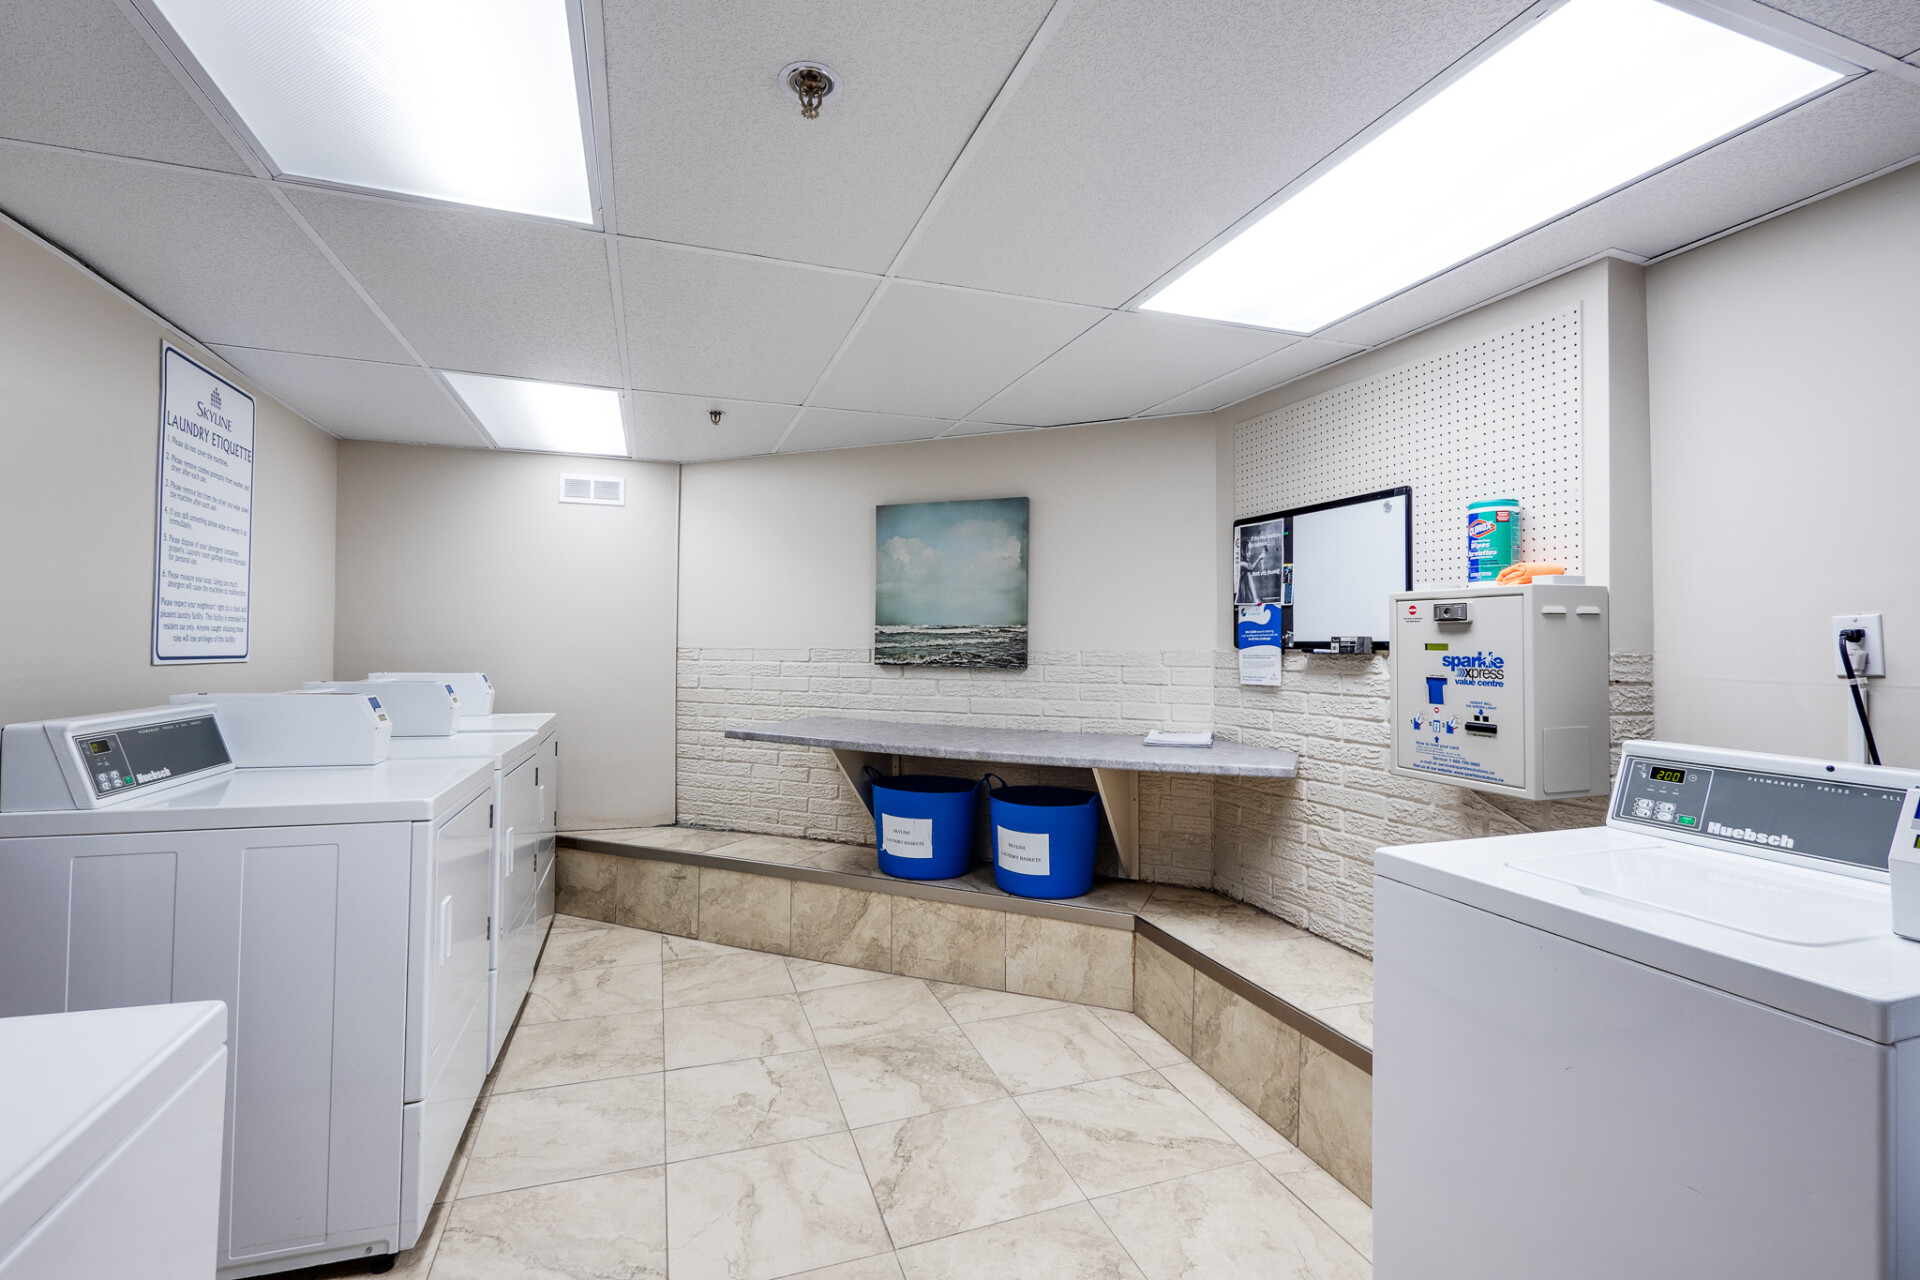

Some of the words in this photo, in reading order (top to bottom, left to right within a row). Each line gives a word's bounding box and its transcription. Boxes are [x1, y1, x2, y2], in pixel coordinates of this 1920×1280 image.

[196, 401, 232, 432] SKYLINE
[167, 410, 209, 443] LAUNDRY
[212, 432, 251, 463] ETIQUETTE
[1464, 668, 1504, 680] xpress
[136, 767, 171, 783] Huebsch
[1656, 771, 1680, 781] 200
[1748, 777, 1805, 788] PERMANENT
[1817, 786, 1850, 794] PRESS
[1707, 821, 1794, 849] Huebsch
